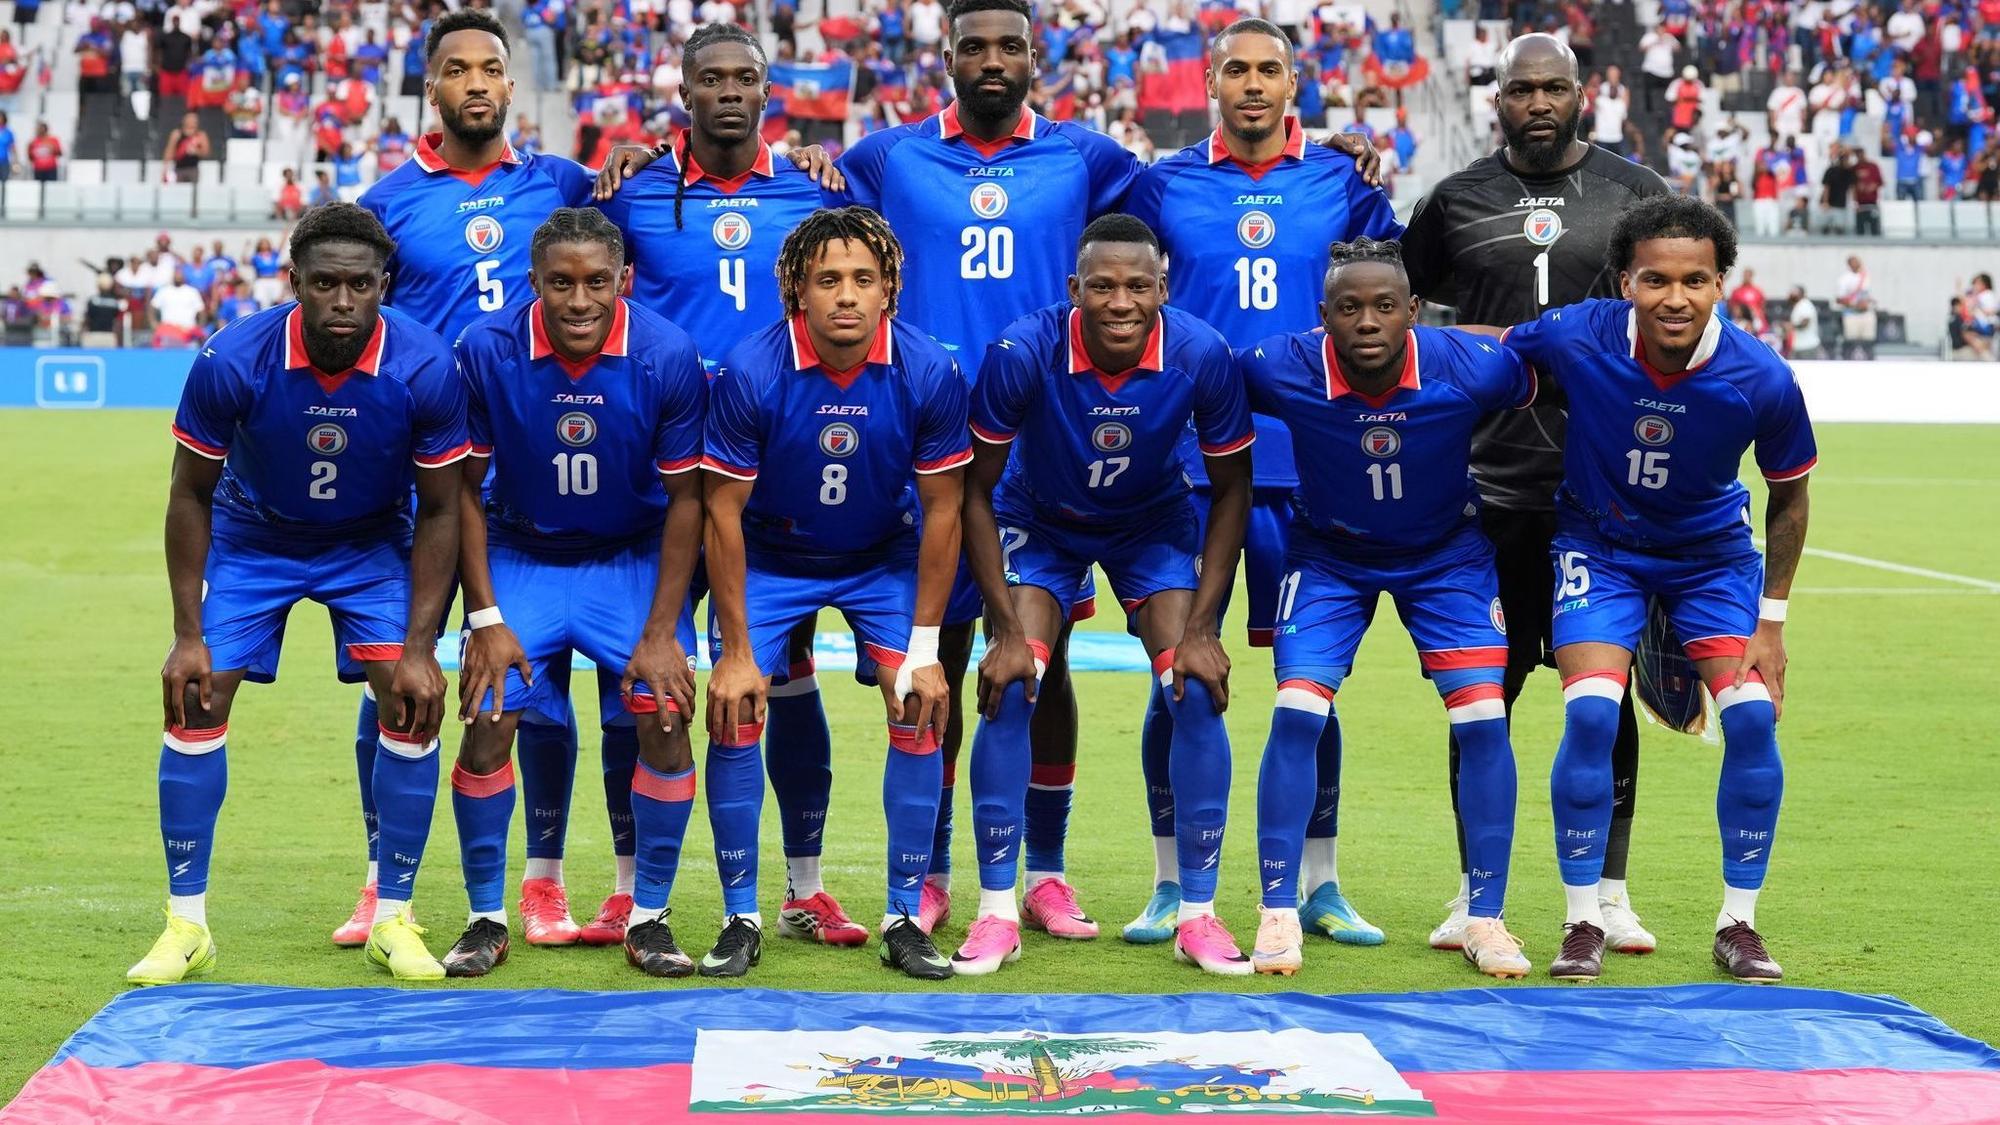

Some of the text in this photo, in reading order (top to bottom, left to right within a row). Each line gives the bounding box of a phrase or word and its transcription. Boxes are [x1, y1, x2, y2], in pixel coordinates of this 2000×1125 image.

[965, 167, 1015, 178] SAETA
[456, 196, 504, 214] SAETA
[706, 197, 759, 209] SAETA
[1232, 194, 1283, 205] SAETA
[1513, 197, 1565, 210] SAETA
[961, 225, 1014, 279] 20
[719, 257, 746, 312] 4
[1233, 256, 1278, 311] 18
[1533, 252, 1549, 306] 1
[475, 259, 505, 313] 5
[552, 393, 603, 405] SAETA
[303, 405, 357, 417] SAETA
[815, 404, 868, 416] SAETA
[1088, 406, 1140, 417] SAETA
[1634, 398, 1686, 416] SAETA
[1355, 412, 1407, 422] SAETA
[551, 452, 598, 496] 10
[1087, 456, 1131, 489] 17
[1626, 448, 1671, 490] 15
[310, 460, 338, 500] 2
[819, 463, 848, 505] 8
[1366, 463, 1403, 501] 11
[1276, 571, 1301, 623] 11
[1274, 624, 1297, 636] ETA
[1612, 778, 1630, 787] HF
[364, 812, 379, 822] FH
[535, 809, 560, 818] FHF
[802, 810, 825, 821] FHF
[990, 826, 1015, 837] FHF
[1203, 827, 1224, 841] FHF
[1567, 829, 1597, 839] FHF
[1740, 829, 1768, 840] FHF
[167, 839, 196, 851] FHF
[394, 852, 417, 866] FHF
[721, 849, 746, 862] FHF
[902, 854, 928, 864] FHF
[1264, 860, 1285, 870] FHF
[1472, 868, 1493, 880] FHF
